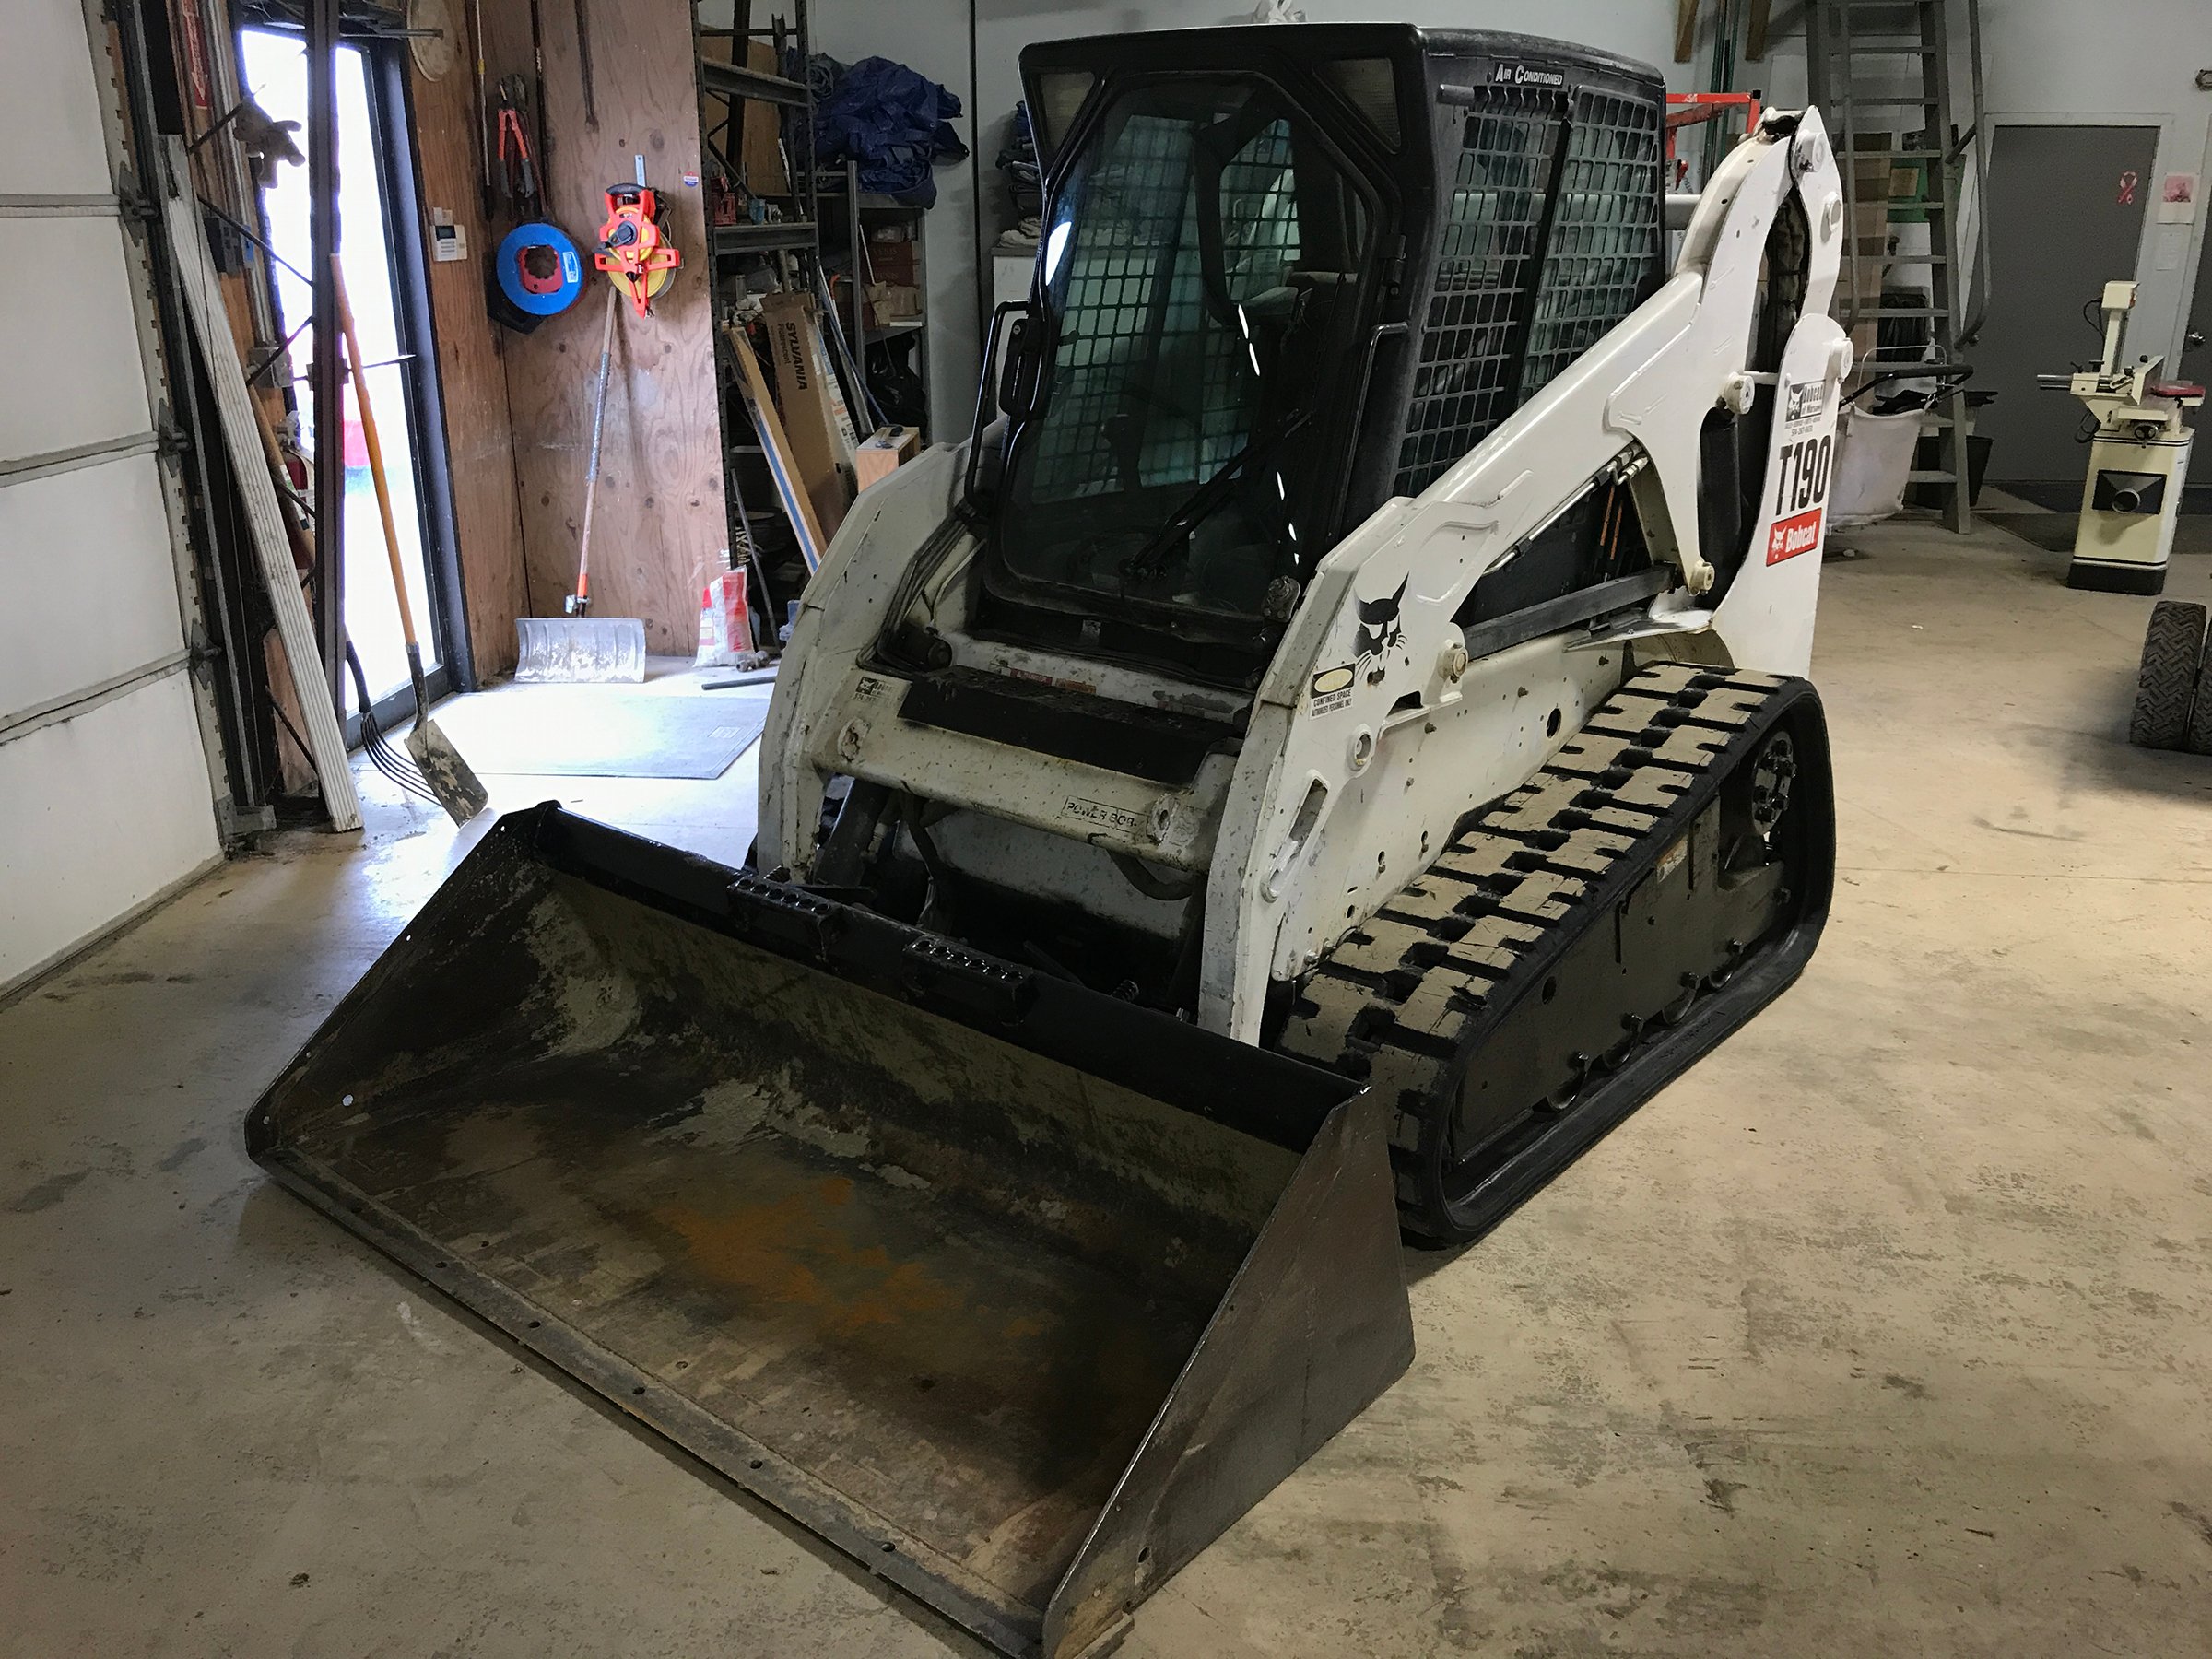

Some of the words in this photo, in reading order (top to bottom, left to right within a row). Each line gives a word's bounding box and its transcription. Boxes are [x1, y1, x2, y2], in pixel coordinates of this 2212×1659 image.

[1514, 65, 1563, 85] CONDITIONED
[785, 322, 808, 390] SYLVANIA
[1775, 434, 1831, 516] T190
[1784, 521, 1817, 553] Bobcat
[1314, 694, 1335, 707] CONFINED
[1337, 689, 1351, 700] SPACE
